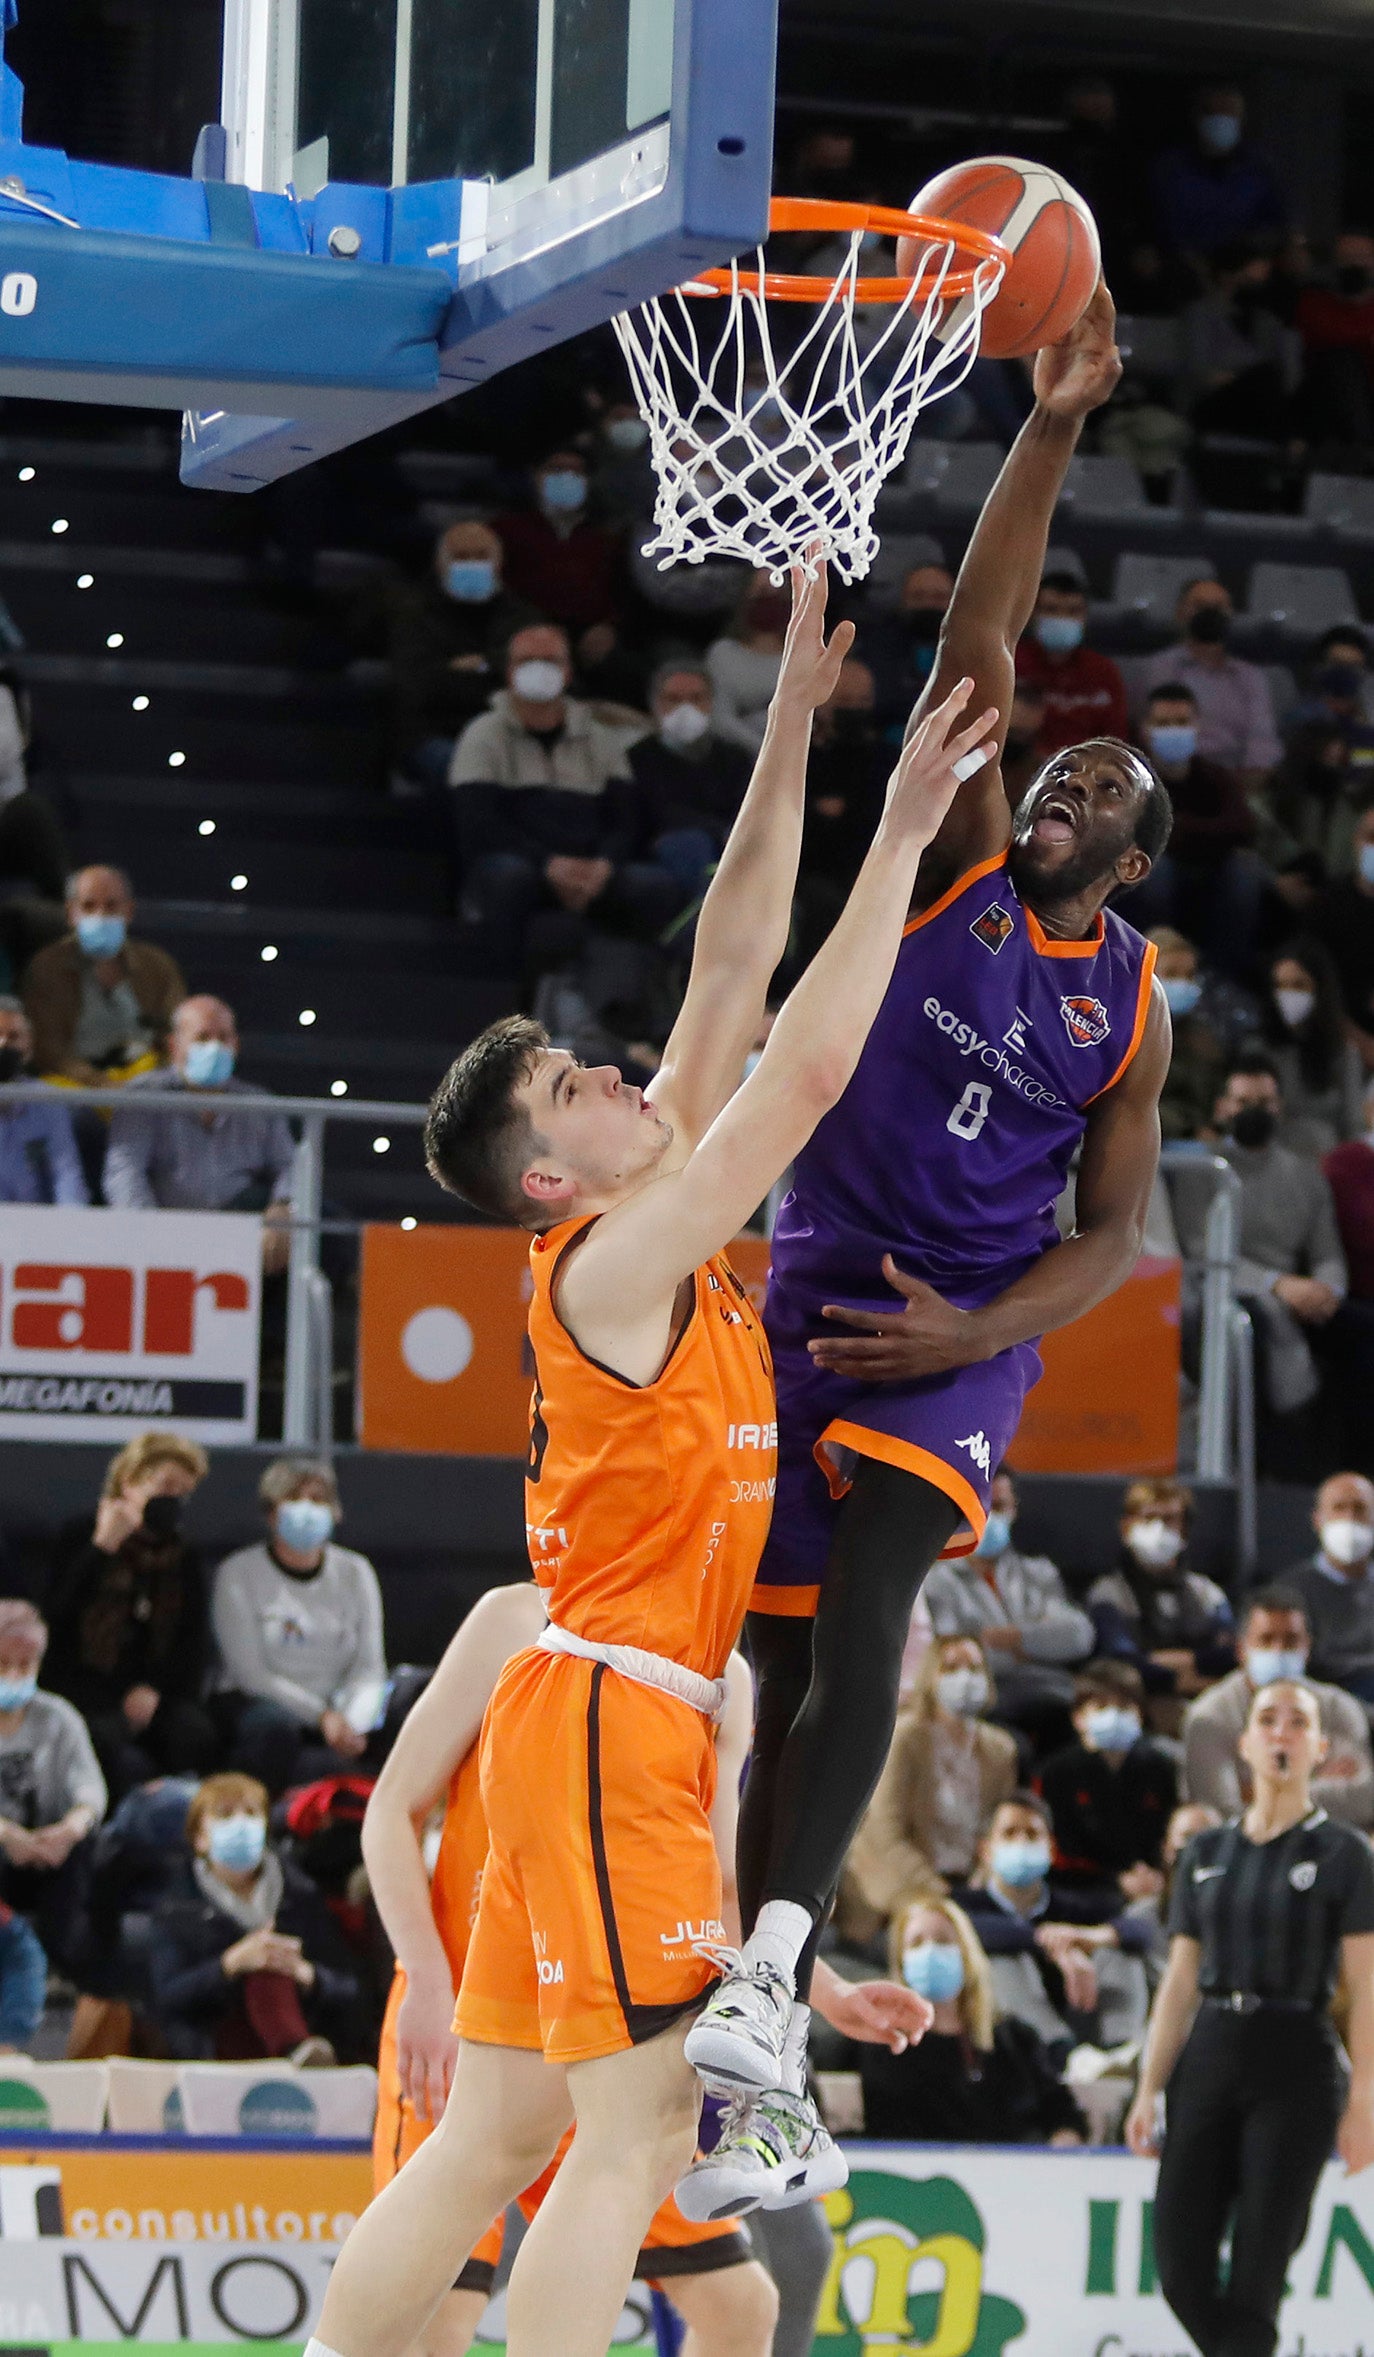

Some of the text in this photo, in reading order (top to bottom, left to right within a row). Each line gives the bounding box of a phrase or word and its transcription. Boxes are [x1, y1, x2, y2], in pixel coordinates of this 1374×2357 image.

[946, 1081, 993, 1141] 8
[0, 1263, 249, 1356] ar
[62, 2254, 338, 2342] MO
